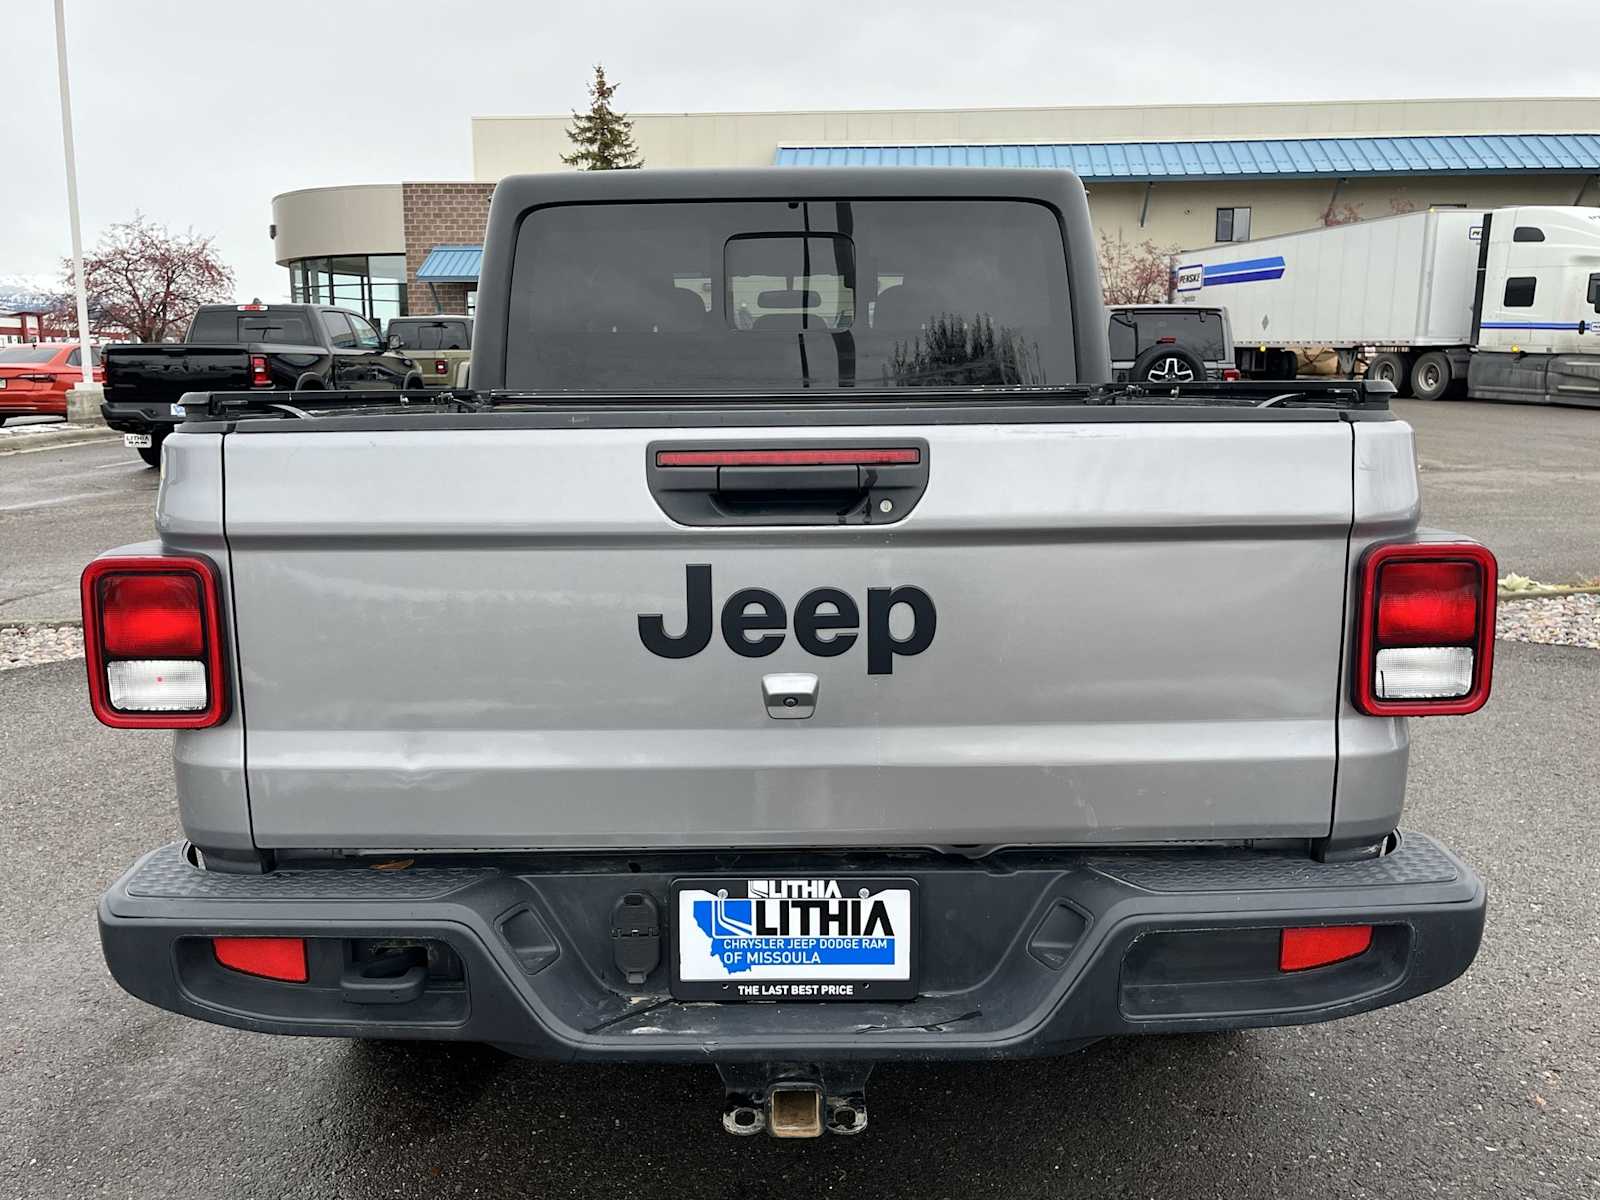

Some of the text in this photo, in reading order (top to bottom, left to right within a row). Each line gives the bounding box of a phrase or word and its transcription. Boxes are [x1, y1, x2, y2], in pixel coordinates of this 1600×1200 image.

[637, 563, 937, 675] Jeep
[768, 880, 842, 898] LITHIA
[756, 900, 895, 936] LITHIA
[723, 938, 887, 949] CHRYSLER JEEP DODGE RAM
[723, 951, 821, 964] OF MISSOULA
[738, 984, 853, 996] THE LAST BEST PRICE
